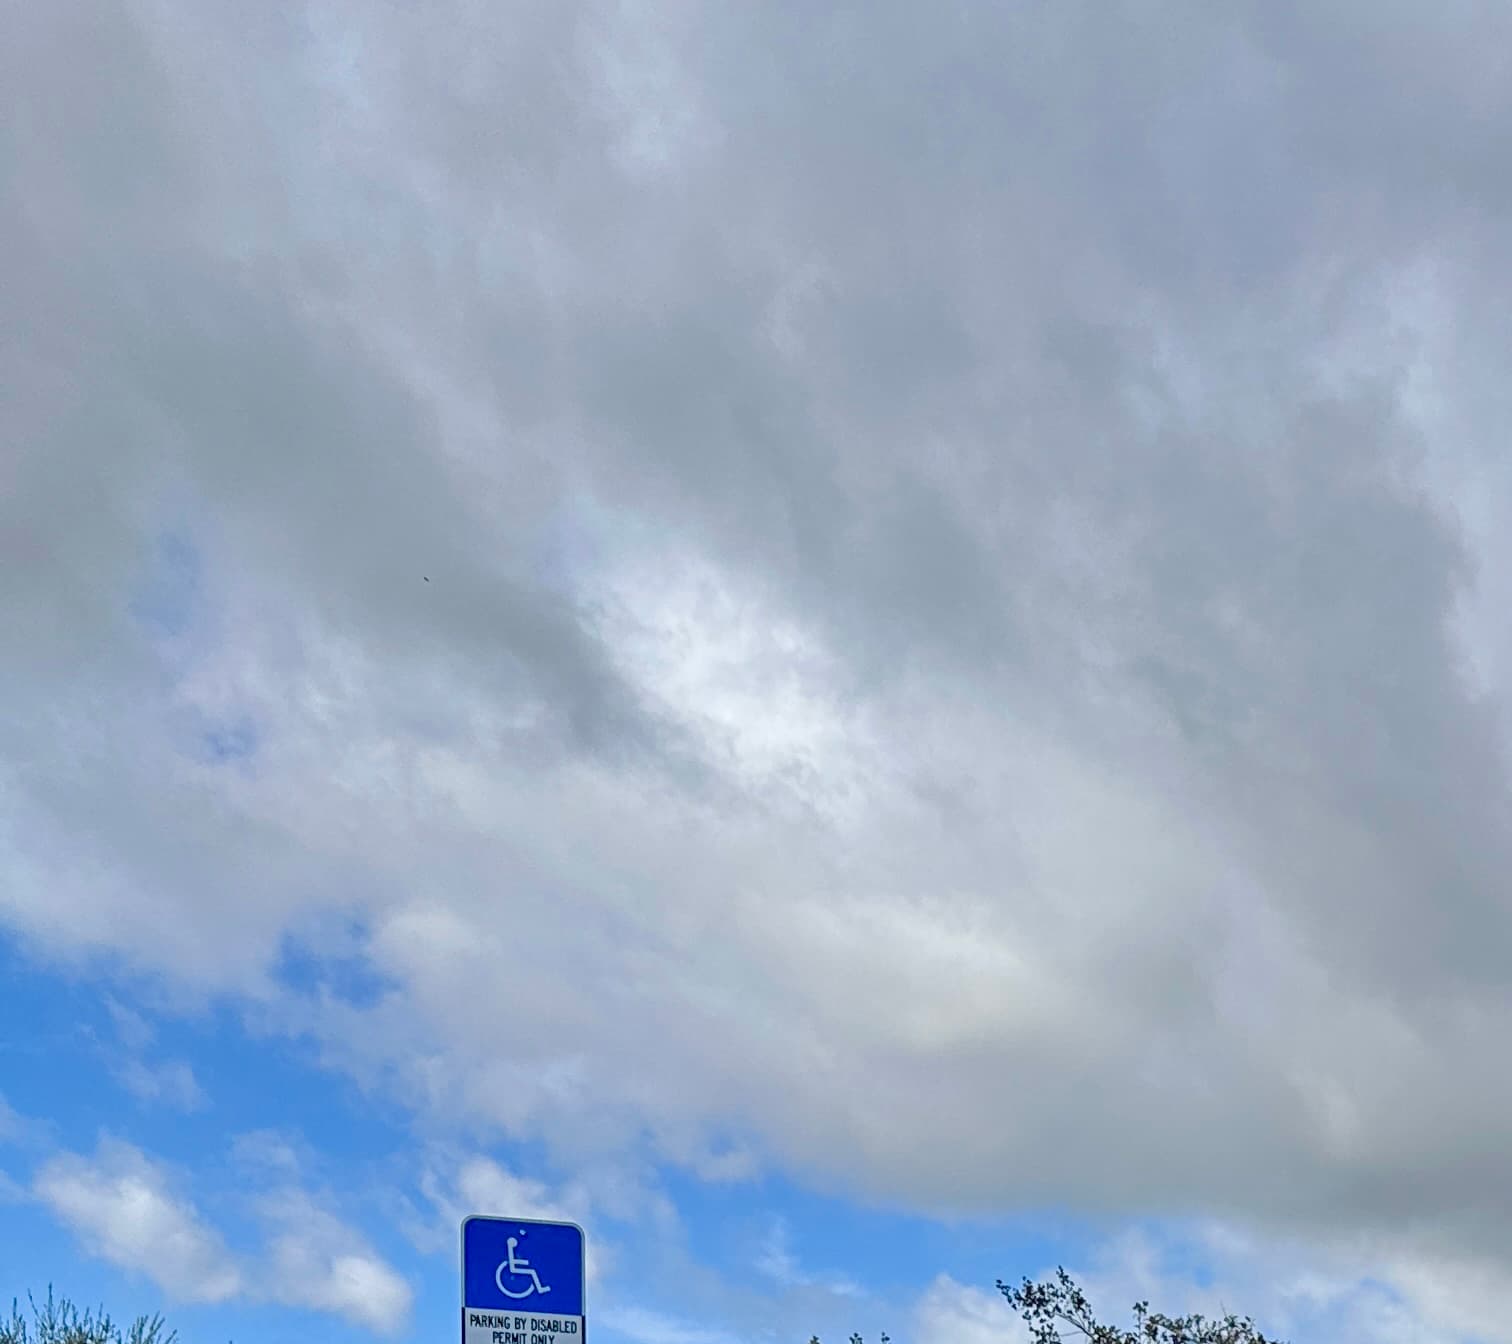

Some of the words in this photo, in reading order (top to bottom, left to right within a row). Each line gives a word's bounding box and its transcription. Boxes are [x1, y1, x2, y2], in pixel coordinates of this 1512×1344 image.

[470, 1314, 510, 1330] PARKING
[514, 1317, 527, 1330] BY
[531, 1318, 577, 1334] DISABLED
